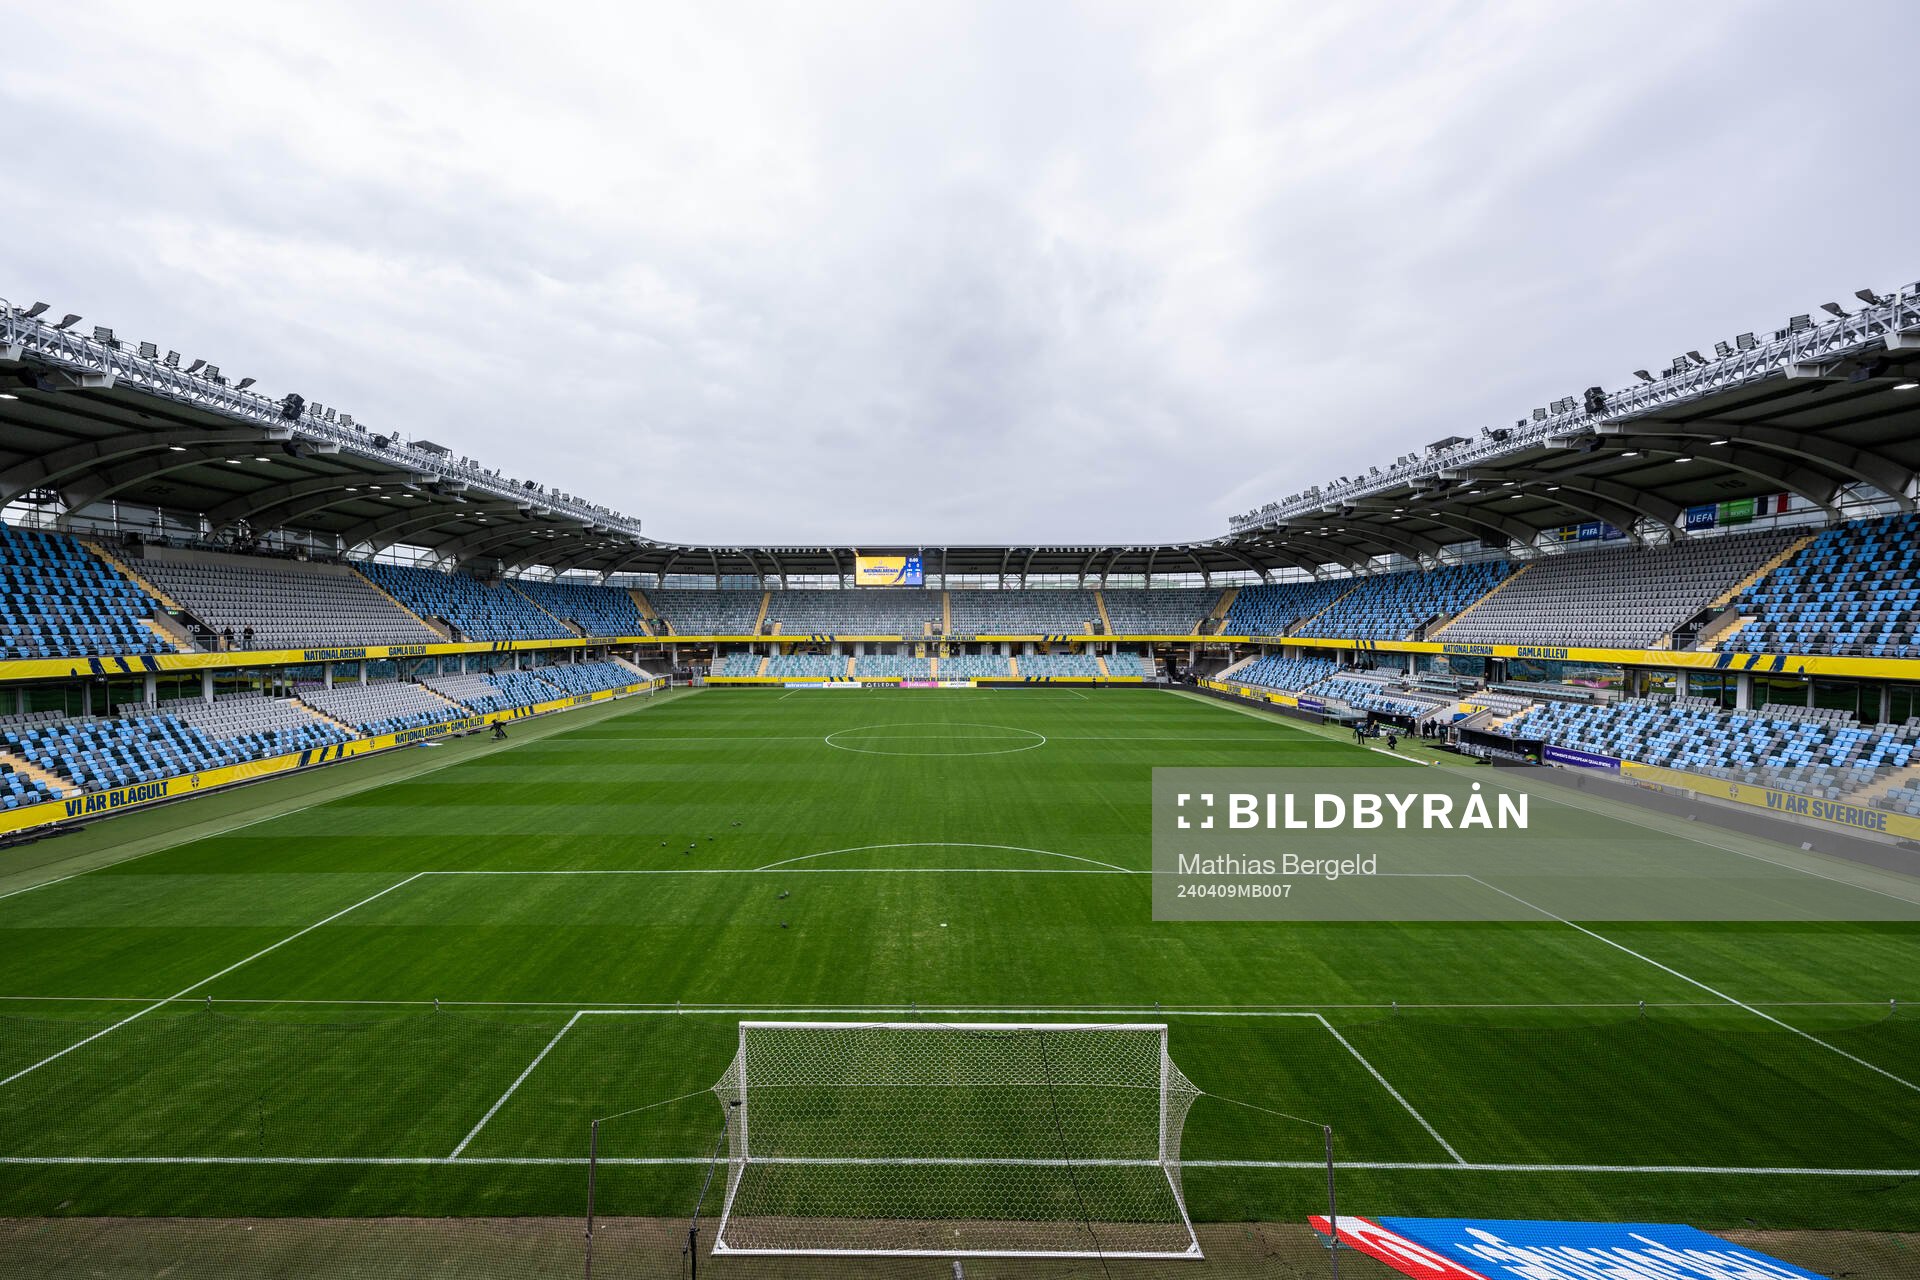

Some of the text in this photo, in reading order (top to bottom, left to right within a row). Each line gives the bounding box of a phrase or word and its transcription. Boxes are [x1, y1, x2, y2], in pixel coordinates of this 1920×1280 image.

[1687, 513, 1713, 524] UEFA
[1582, 527, 1598, 536] FIFA
[304, 645, 426, 660] NATIONALARENAN GAMLA ULLEVI
[1443, 644, 1568, 659] NATIONALARENAN GAMLA ULLEVI
[395, 723, 447, 744] NATIONALARENAN
[451, 719, 469, 733] GAMLA
[469, 716, 485, 729] ULLEVI
[1551, 751, 1611, 768] WOMEN'S EUROPEAN QUALIFIERS
[65, 782, 168, 816] VI ÄR BLÅGULT
[1766, 791, 1887, 831] VI ÄR SVERIGE
